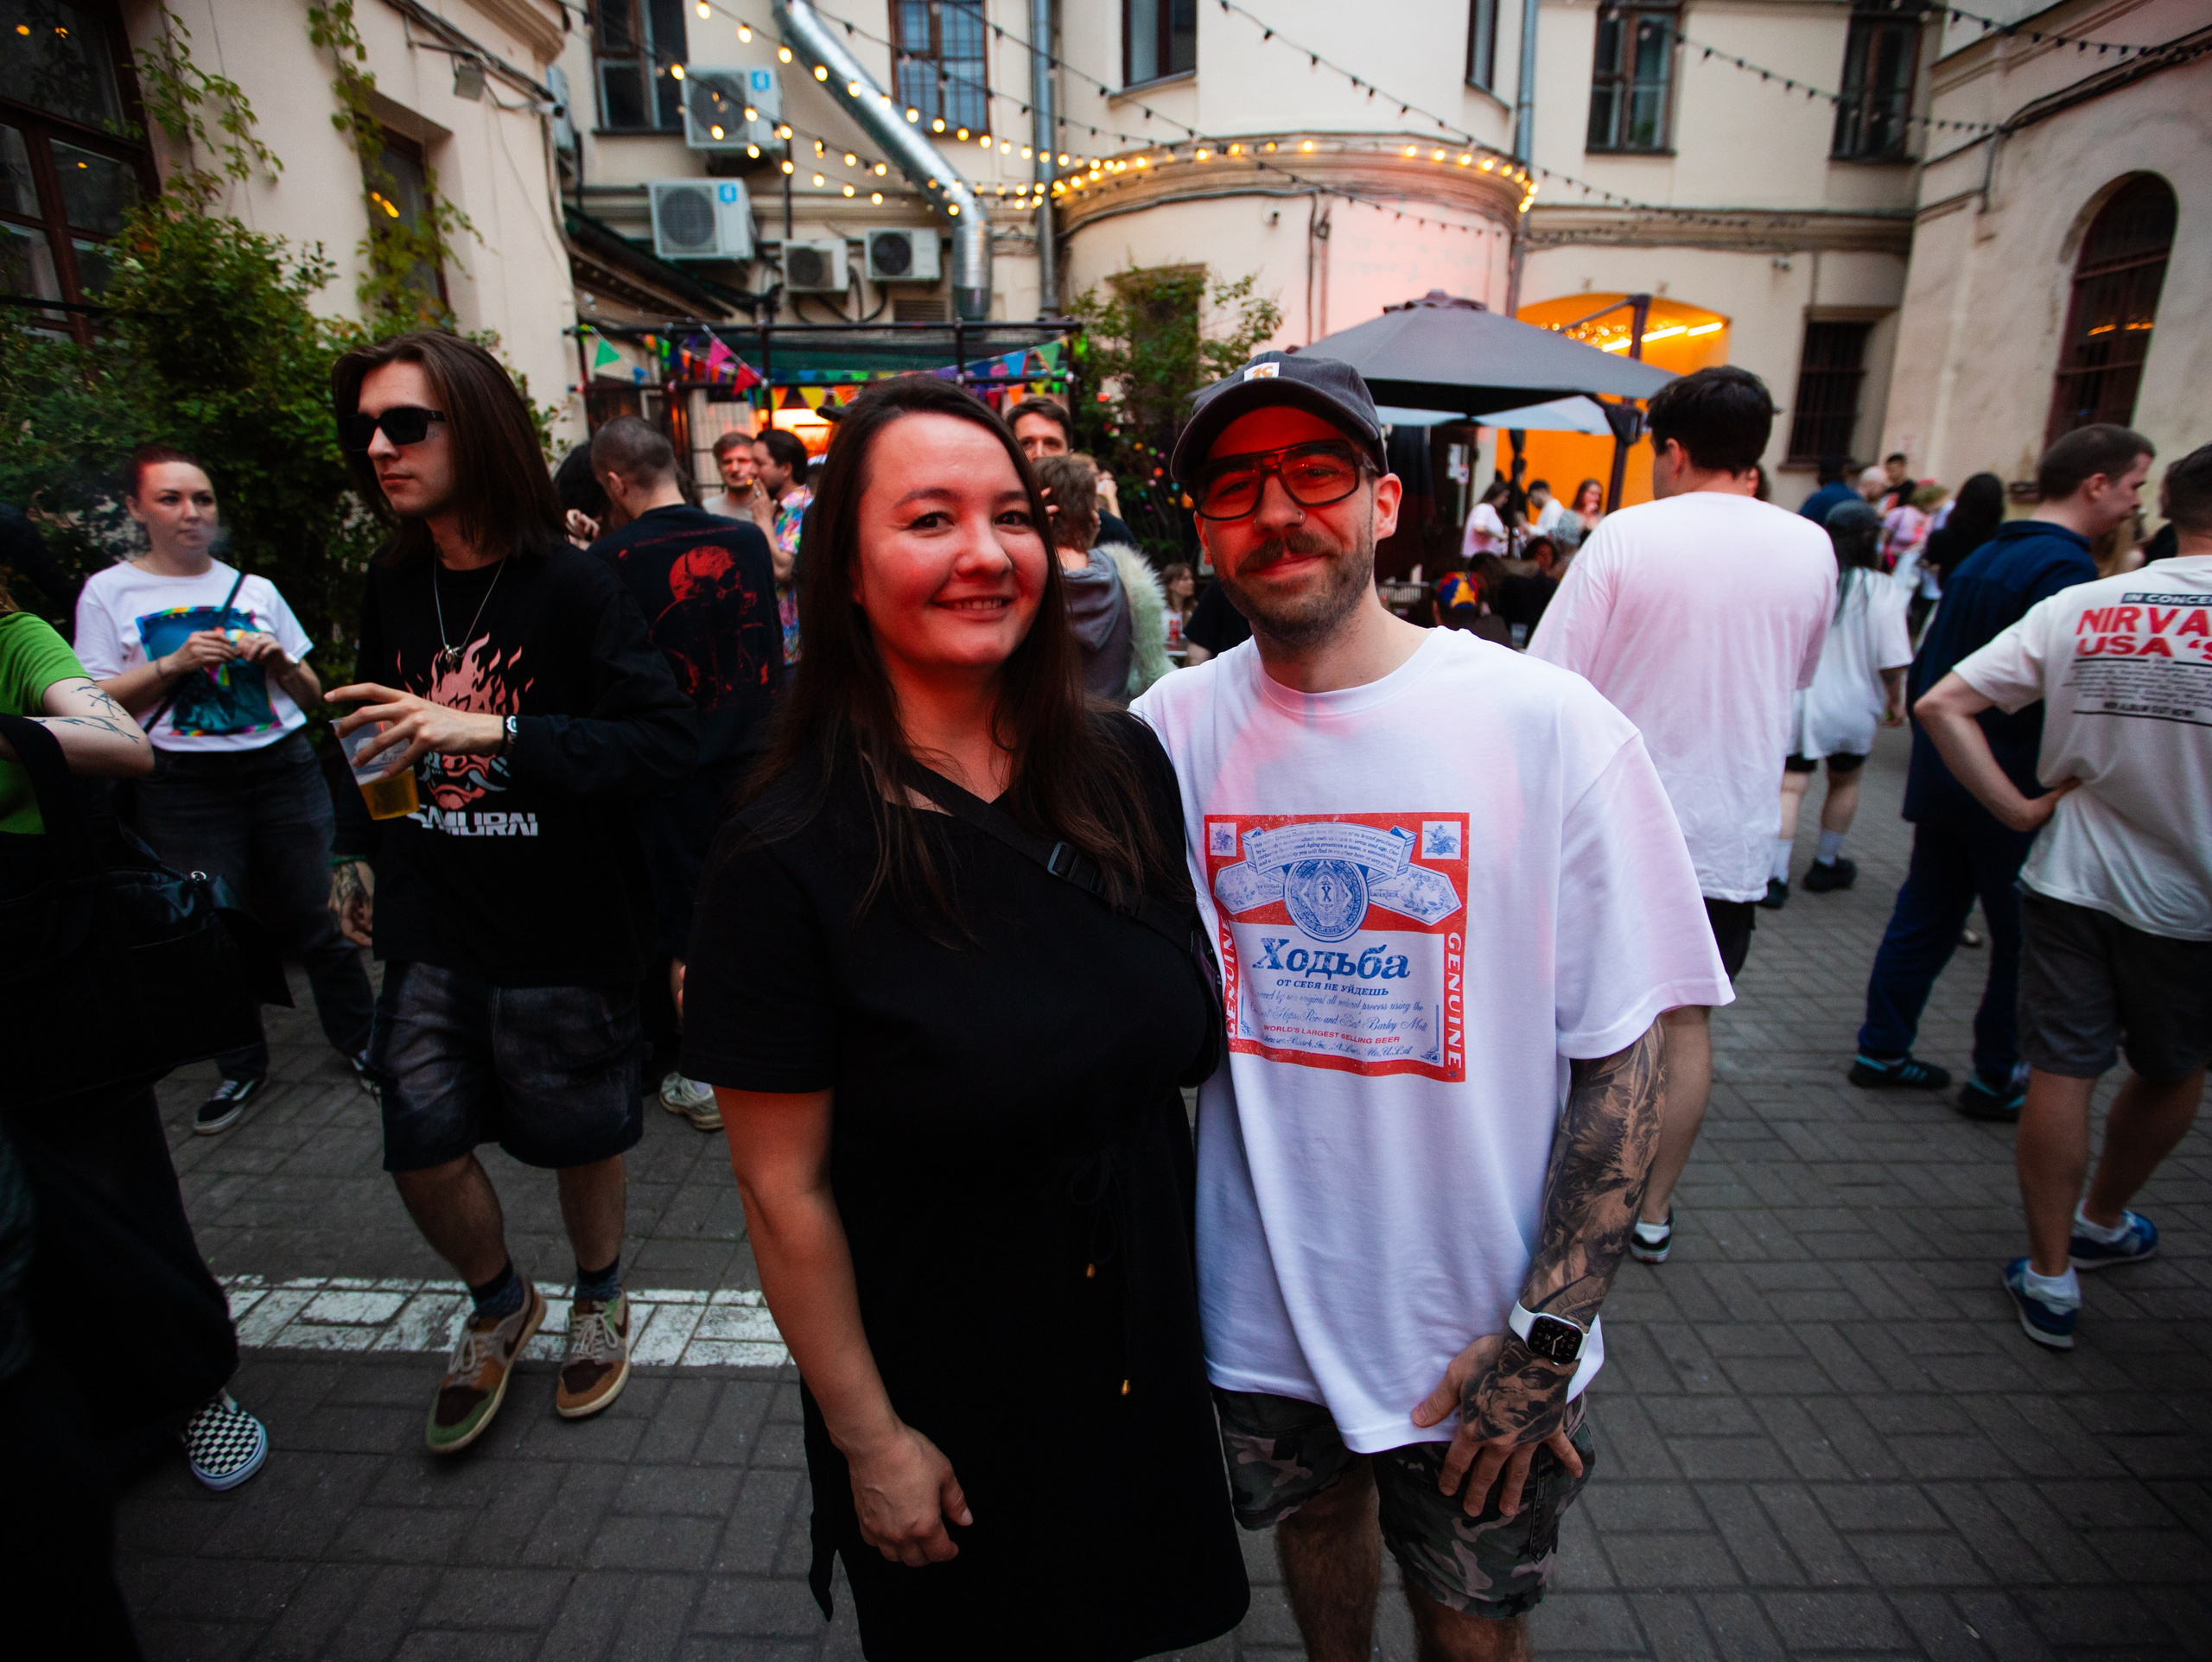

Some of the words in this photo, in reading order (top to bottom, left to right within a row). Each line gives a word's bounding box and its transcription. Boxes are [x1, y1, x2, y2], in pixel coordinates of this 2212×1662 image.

[2146, 594, 2212, 605] CONCE
[2075, 636, 2174, 657] USA
[1252, 937, 1411, 980] Ходьба
[1294, 980, 1322, 991] СЕБЯ
[1323, 982, 1339, 992] НЕ
[1340, 983, 1389, 996] УЙДЕШЬ
[1326, 994, 1338, 1005] all
[1389, 999, 1411, 1014] using
[1413, 1000, 1424, 1012] the
[1447, 931, 1462, 1069] GENUINE
[1263, 1024, 1300, 1033] WORLD'S
[1301, 1028, 1340, 1038] LARGEST
[1340, 1033, 1373, 1044] SELLING
[1375, 1036, 1401, 1044] BEER
[1362, 1017, 1398, 1034] Barley
